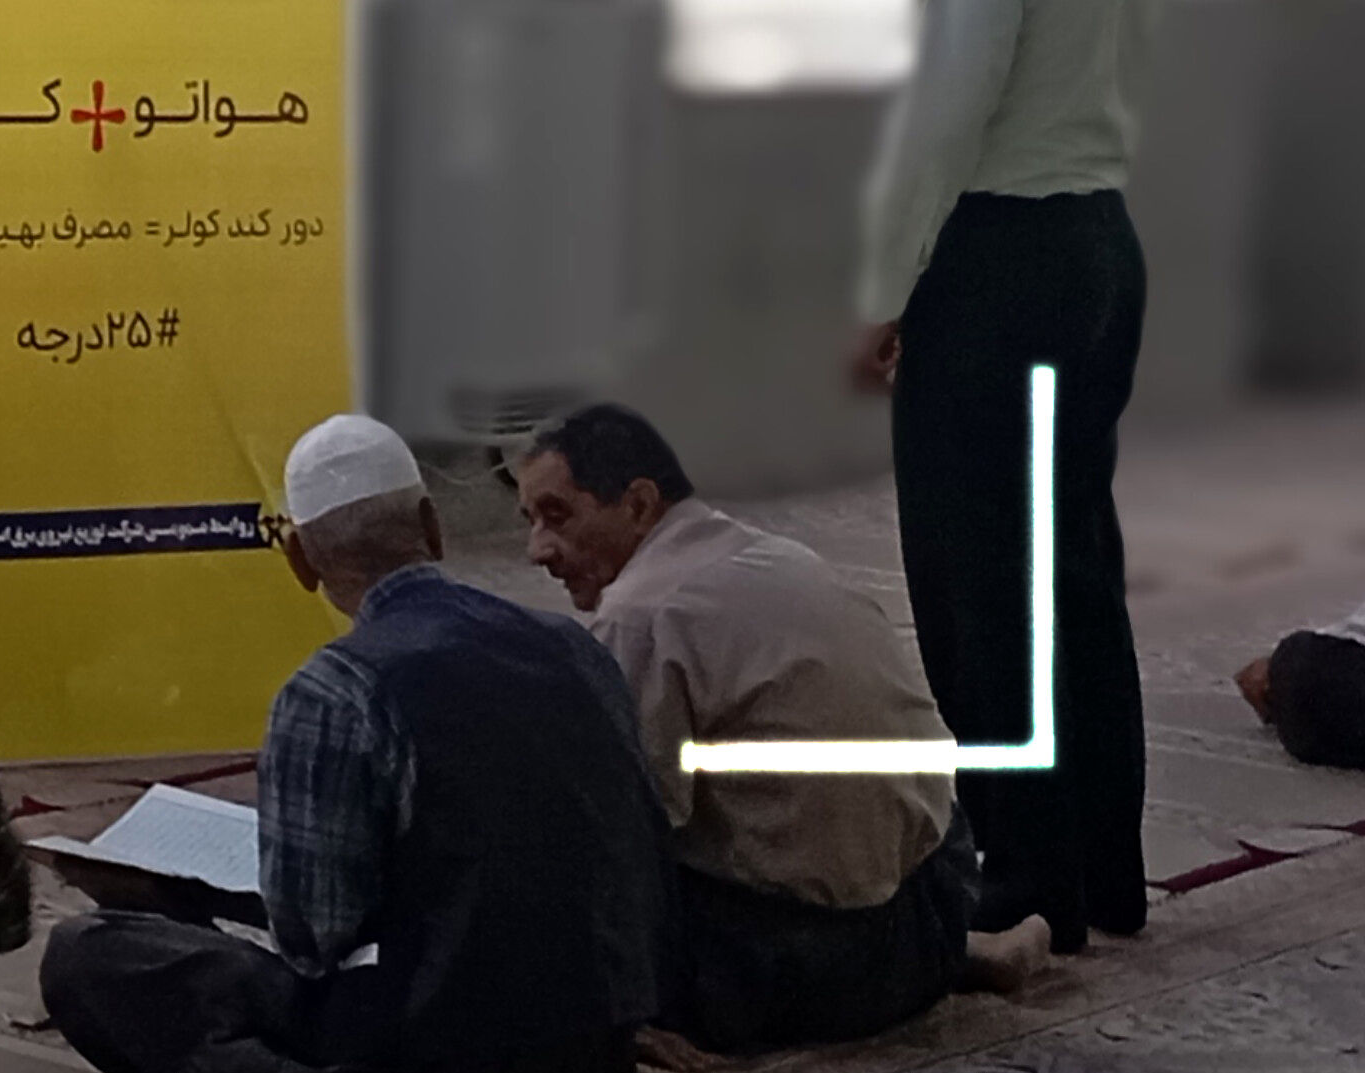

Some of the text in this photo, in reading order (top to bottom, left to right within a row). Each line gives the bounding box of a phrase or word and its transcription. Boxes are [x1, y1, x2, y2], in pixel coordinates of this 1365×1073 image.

[132, 79, 310, 139] هواتو
[51, 207, 133, 250] مصرف
[226, 208, 272, 239] کند
[279, 214, 325, 247] دور
